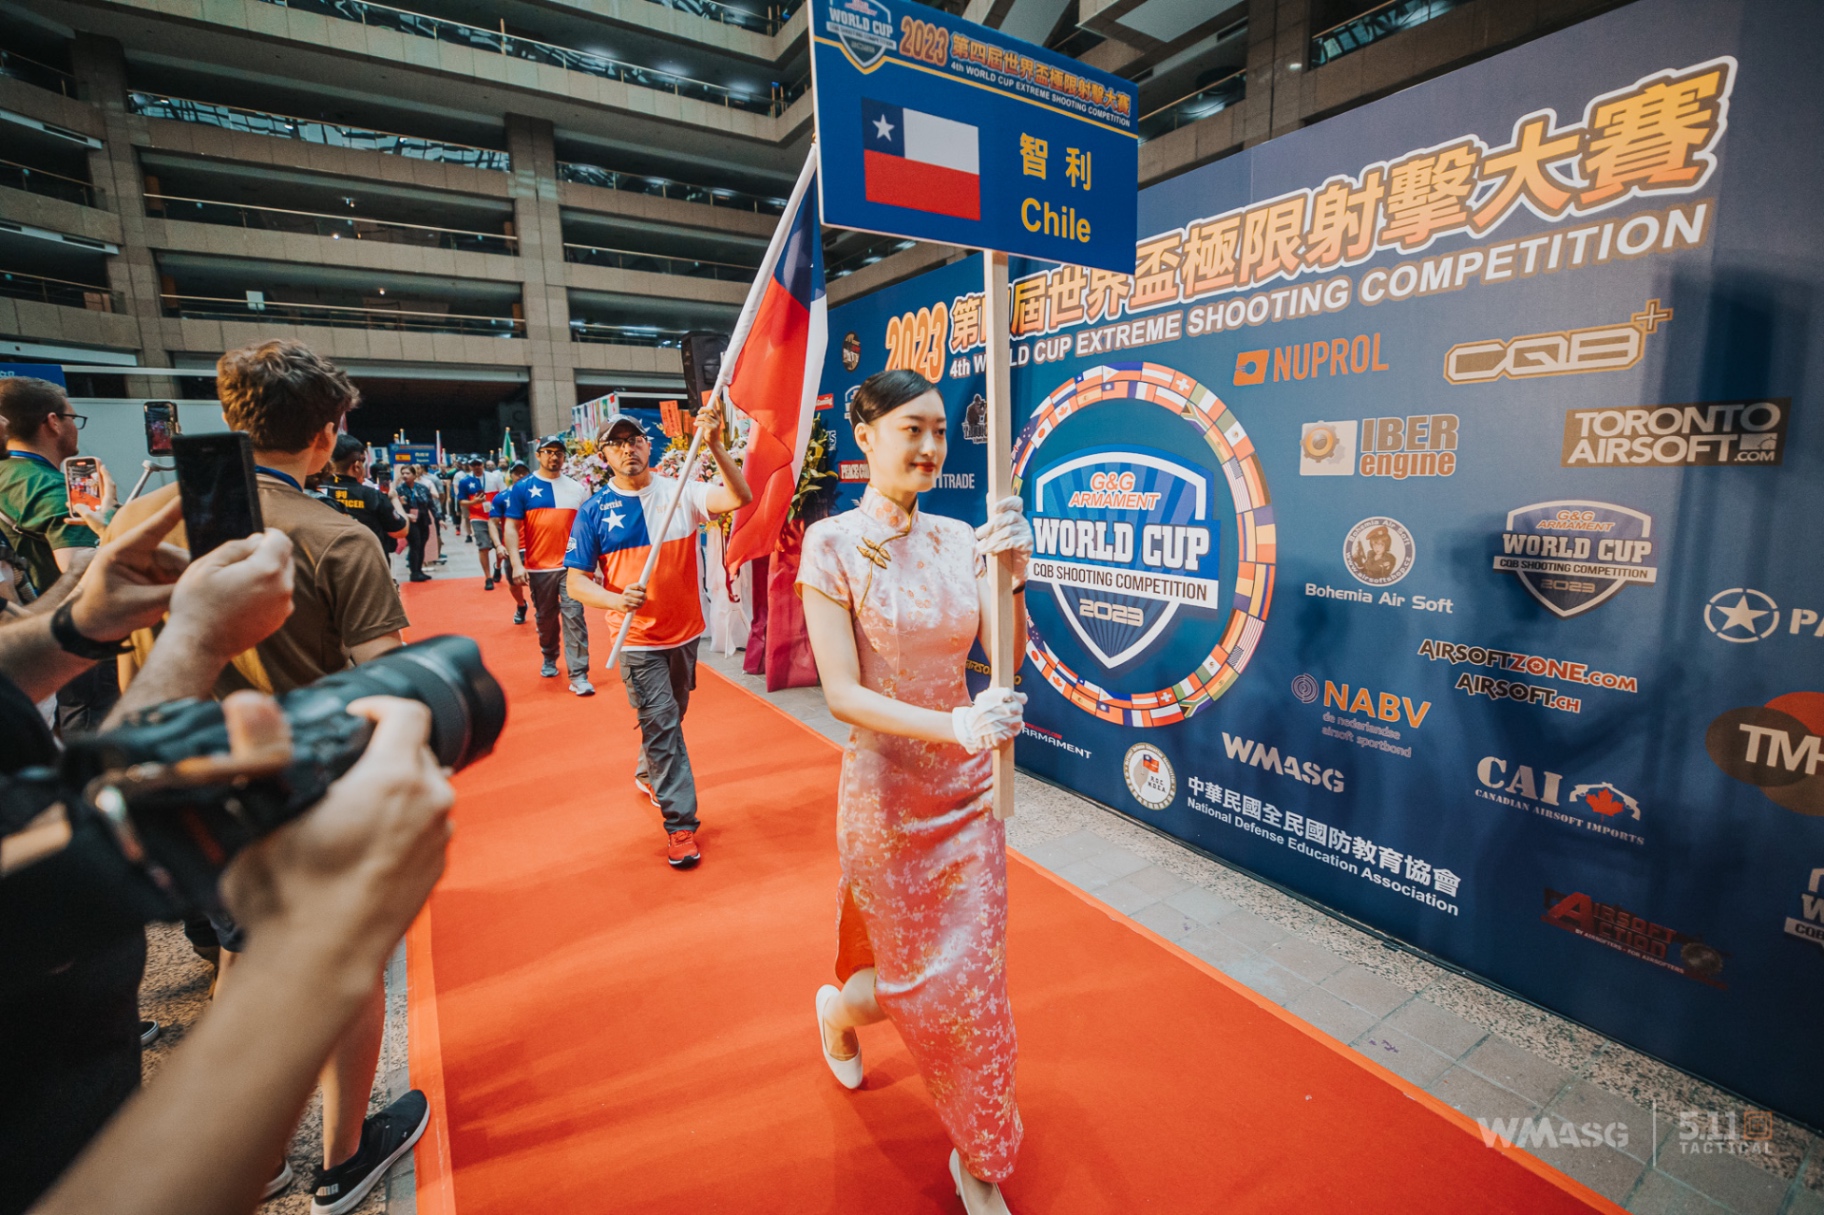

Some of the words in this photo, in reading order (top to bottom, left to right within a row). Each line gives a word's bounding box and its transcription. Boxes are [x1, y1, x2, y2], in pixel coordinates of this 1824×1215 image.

[829, 7, 869, 32] WORLD
[872, 20, 893, 38] CUP
[899, 16, 949, 67] 2023
[951, 61, 965, 73] 4th
[966, 65, 996, 83] WORLD
[998, 76, 1014, 90] CUP
[1016, 81, 1050, 100] EXTREME
[1052, 94, 1087, 112] SHOOTING
[1088, 106, 1131, 127] COMPETITION
[1021, 197, 1091, 243] Chile
[950, 357, 970, 379] 4th
[1034, 337, 1071, 361] CUP
[1076, 313, 1181, 355] EXTREME
[1188, 279, 1349, 333] SHOOTING
[1361, 204, 1708, 299] COMPETITION
[885, 302, 948, 384] 2023
[1273, 333, 1389, 383] NUPROL
[1361, 414, 1459, 453] IBER
[1575, 402, 1781, 437] TORONTO
[1359, 452, 1457, 480] engine
[1567, 434, 1739, 464] AIRSOFT
[1068, 492, 1161, 510] ARMAMENT
[1090, 471, 1136, 492] G&G
[1536, 520, 1615, 533] ARMAMENT
[1556, 509, 1595, 522] G&G
[1033, 516, 1134, 564] WORLD
[1142, 523, 1210, 572] CUP
[1502, 534, 1591, 560] WORLD
[1597, 539, 1652, 563] CUP
[1033, 563, 1054, 578] CQB
[1056, 566, 1113, 587] SHOOTING
[1115, 573, 1207, 602] COMPETITION
[1500, 558, 1519, 569] CQB
[1521, 559, 1571, 572] SHOOTING
[1573, 564, 1648, 579] COMPETITION
[1540, 579, 1596, 593] 2023
[1079, 598, 1144, 627] 2023
[1305, 583, 1373, 603] Bohemia
[1378, 592, 1405, 607] Air
[1412, 595, 1454, 614] Soft
[1417, 639, 1638, 693] AIRSOFTZONE.COM
[1323, 680, 1432, 729] NABV
[1455, 672, 1581, 714] AIRSOFT.CH
[1221, 732, 1345, 793] WMASG
[1477, 756, 1563, 807] CAI
[1188, 776, 1461, 897] 中華民國全民國防教育協會
[1475, 788, 1530, 811] CANADIAN
[1533, 806, 1584, 828] AIRSOFT
[1587, 821, 1645, 846] IMPORTS
[1187, 797, 1232, 824] National
[1235, 816, 1284, 845] Defense
[1288, 836, 1358, 875] Education
[1361, 867, 1459, 917] Association
